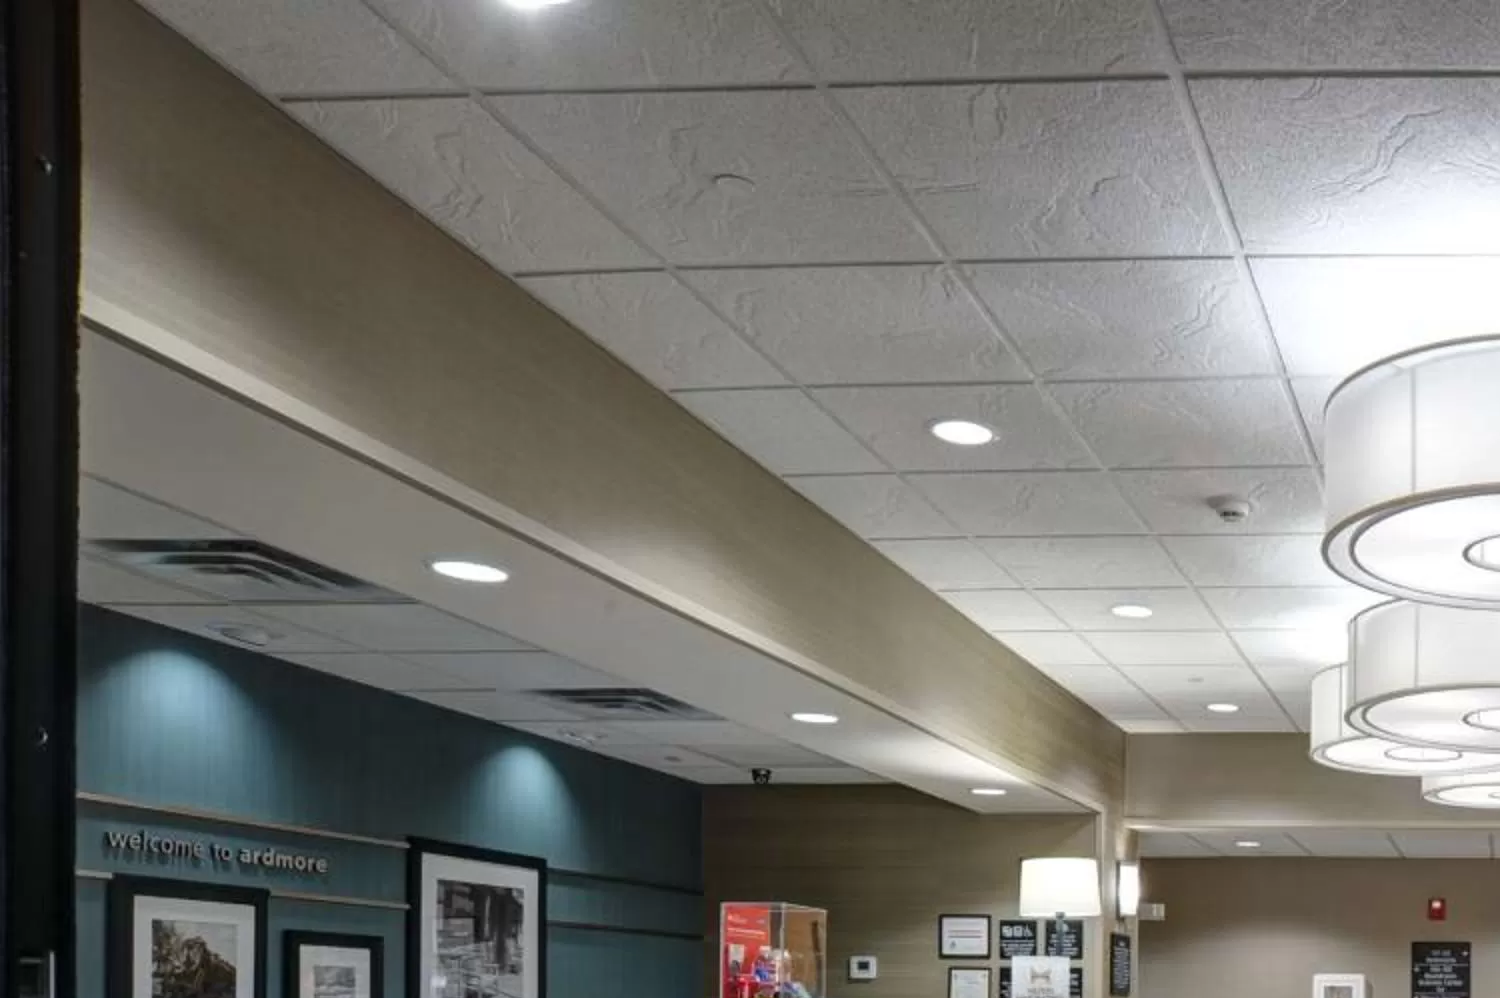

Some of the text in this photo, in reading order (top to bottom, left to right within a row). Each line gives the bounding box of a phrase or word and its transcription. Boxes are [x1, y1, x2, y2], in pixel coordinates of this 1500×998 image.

[106, 829, 328, 873] welcome to ardmore
